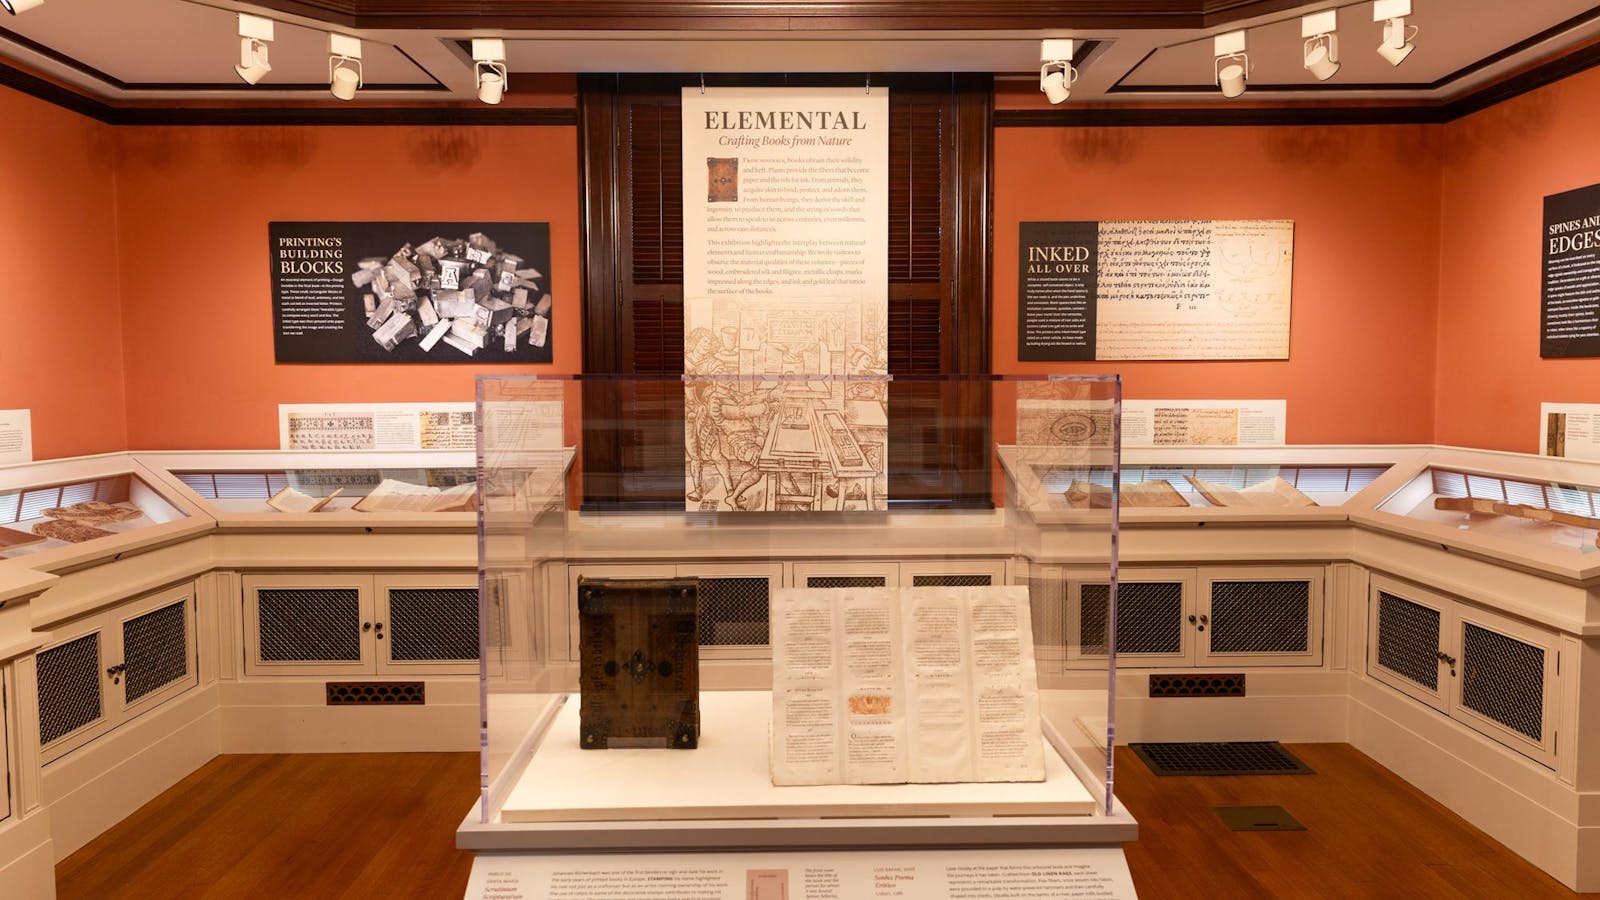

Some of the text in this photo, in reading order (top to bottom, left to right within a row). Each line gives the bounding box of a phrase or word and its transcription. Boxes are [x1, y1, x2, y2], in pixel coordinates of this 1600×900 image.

[704, 111, 867, 130] ELEMENTAL
[718, 135, 852, 149] Crafting Books from Nature
[1549, 219, 1580, 236] SPINES
[280, 237, 342, 247] PRINTING'S
[1549, 229, 1600, 255] EDGES
[280, 249, 343, 259] BUILDING
[1028, 247, 1089, 262] INKED
[280, 260, 344, 274] BLOCKS
[1027, 262, 1090, 274] ALL OVER
